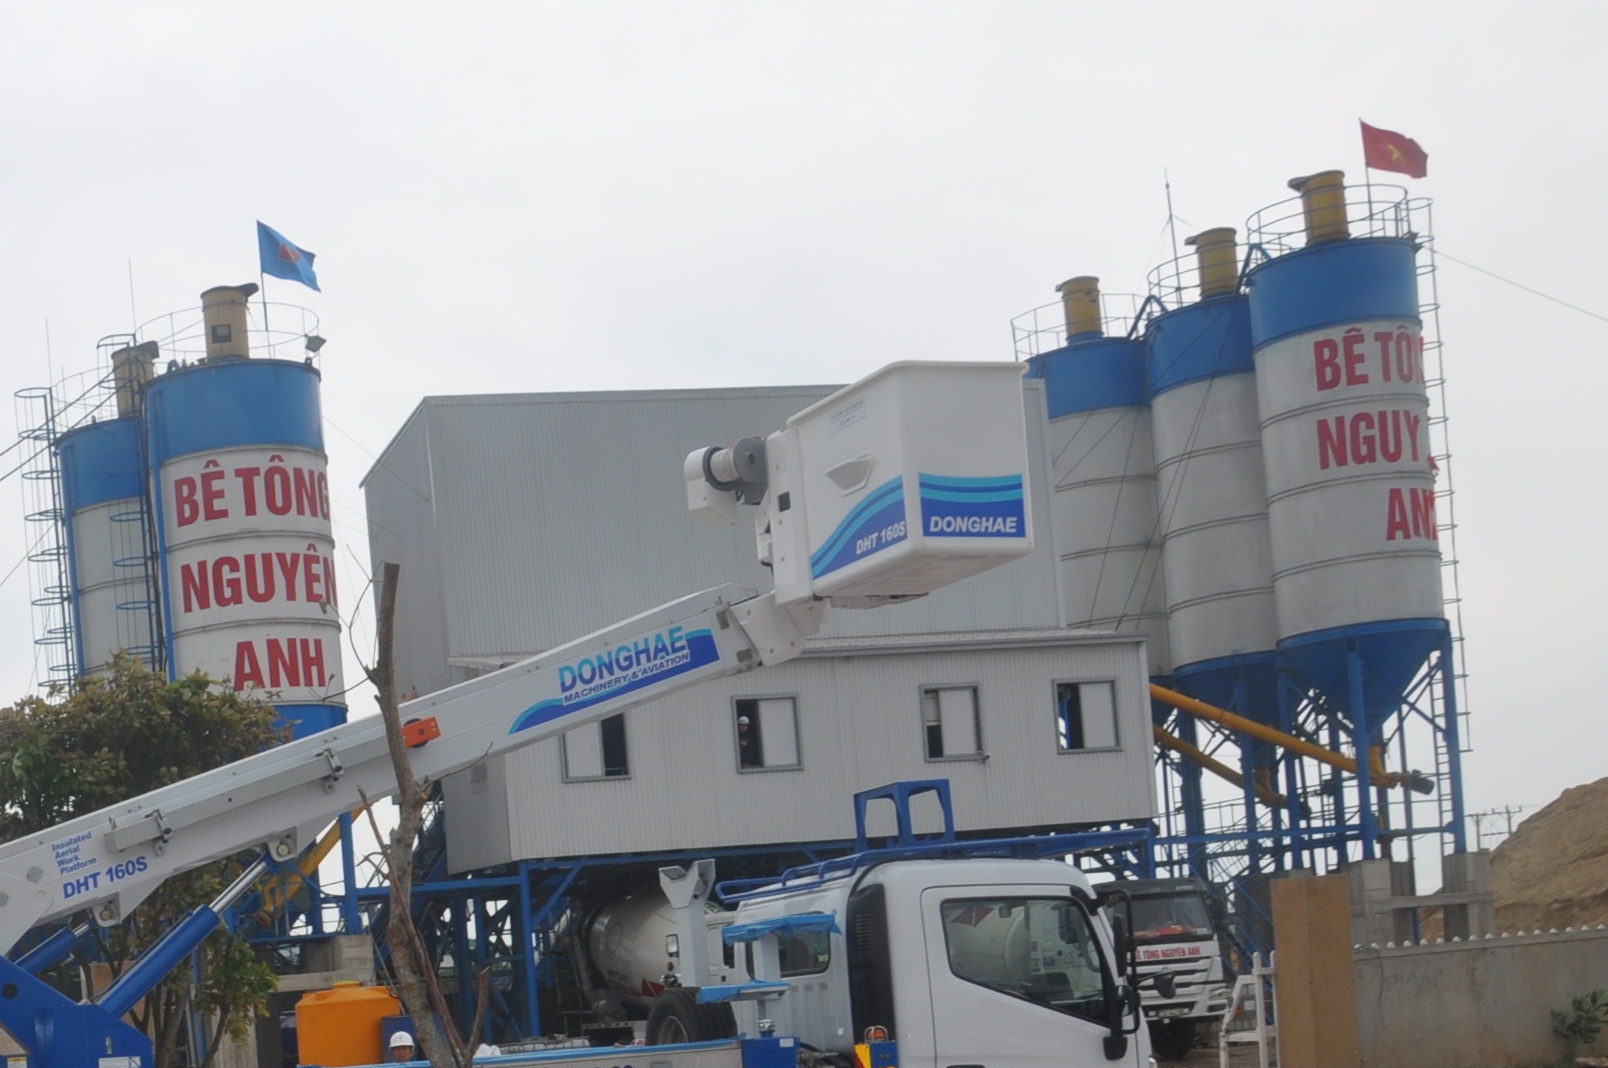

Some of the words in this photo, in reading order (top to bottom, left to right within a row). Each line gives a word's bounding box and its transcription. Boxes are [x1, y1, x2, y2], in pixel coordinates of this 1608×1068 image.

[1313, 327, 1369, 391] BÊ
[174, 459, 229, 528] BÊ
[234, 454, 330, 522] TÔNG
[856, 535, 879, 555] DHT
[880, 521, 907, 543] 160S
[929, 516, 1018, 533] DONGHAE
[181, 543, 337, 614] NGUYÊN
[234, 637, 326, 691] ANH
[558, 625, 688, 694] DONGHAE
[563, 674, 629, 703] MACHINERY
[641, 652, 690, 678] AVIATION
[52, 831, 92, 851] Insulated
[55, 844, 80, 860] Aerial
[57, 854, 80, 868] Work
[60, 857, 97, 876] Platform
[63, 871, 101, 899] DHT
[105, 856, 149, 883] 160S
